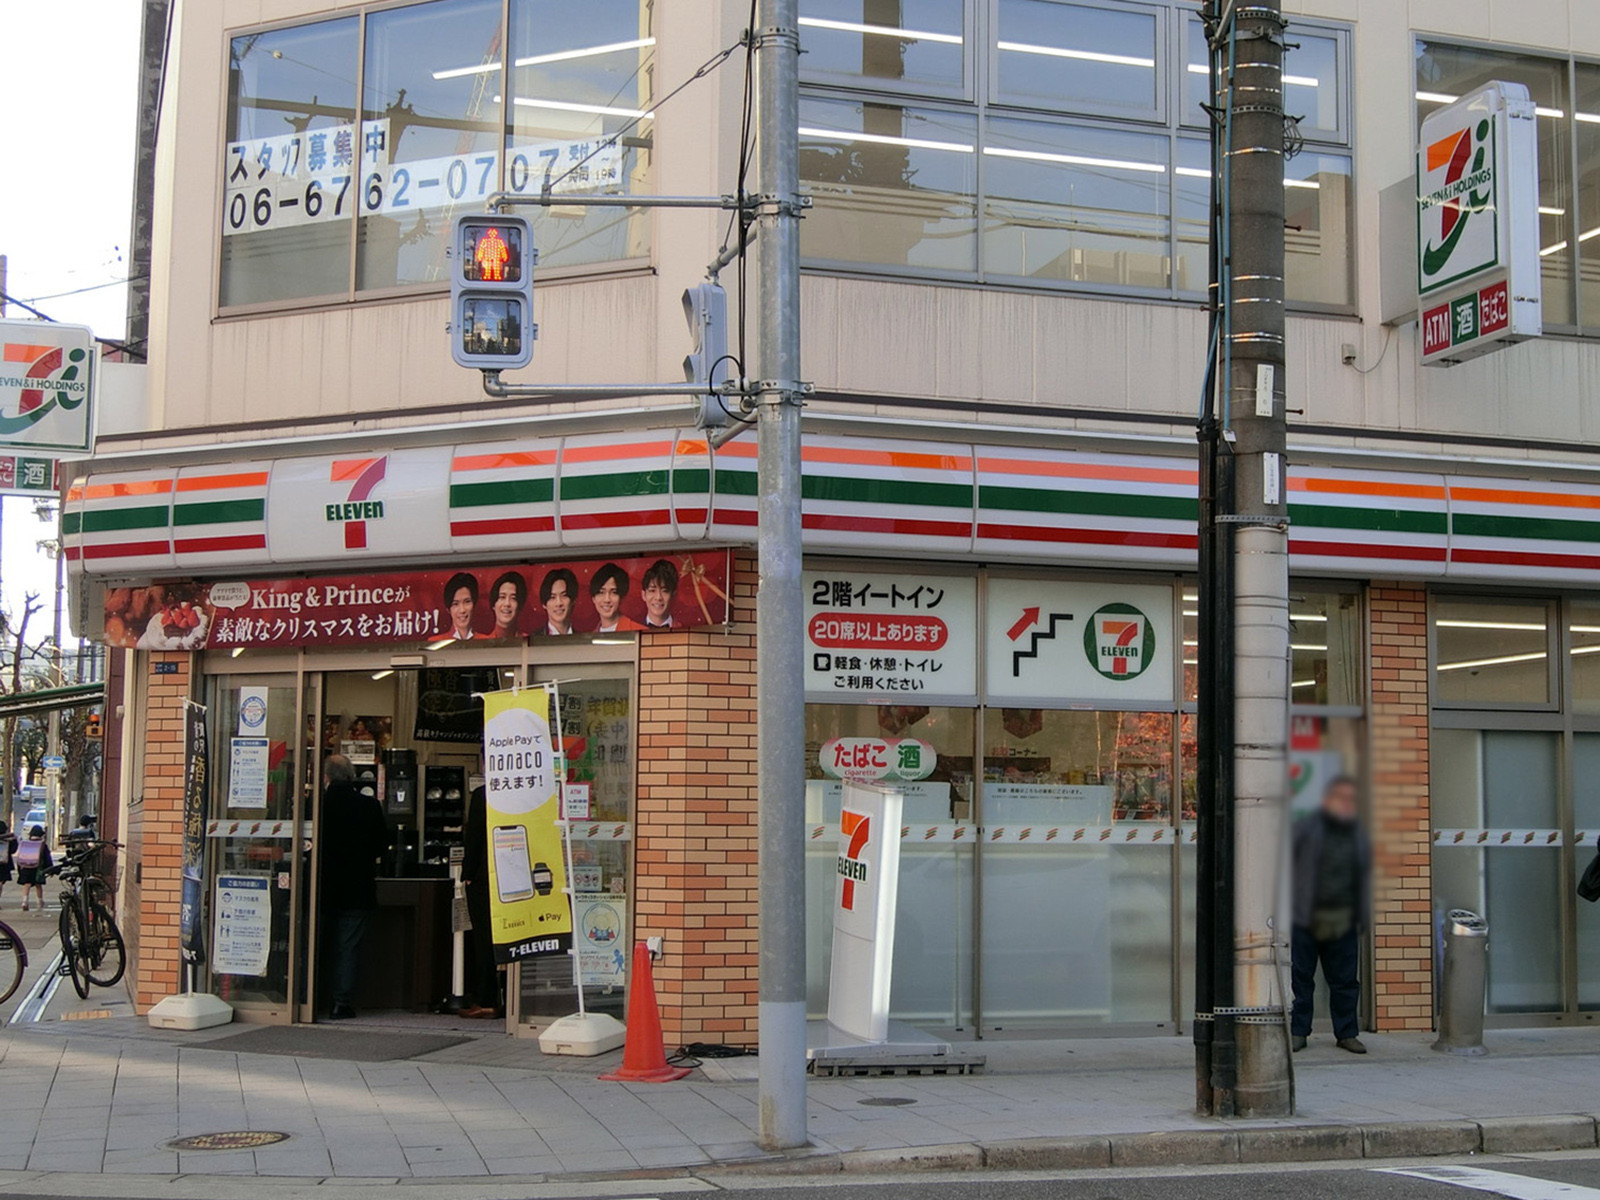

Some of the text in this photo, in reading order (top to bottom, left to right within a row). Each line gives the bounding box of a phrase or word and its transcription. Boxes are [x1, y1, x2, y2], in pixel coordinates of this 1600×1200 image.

[231, 124, 385, 183] スタッフ募集中
[1453, 168, 1491, 193] HOLDINGS
[1456, 302, 1473, 338] 酒
[1481, 291, 1507, 327] たばこ
[1425, 312, 1449, 348] ATM
[36, 379, 85, 392] HOLDINGS
[24, 463, 46, 485] 酒
[251, 589, 303, 613] King
[305, 586, 321, 607] &
[813, 581, 944, 608] 2階イートイン
[216, 609, 440, 642] 素敵なクリスマスをお届け!
[814, 621, 942, 643] 20席以上あります
[834, 656, 943, 672] 軽食・休憩・トイレ
[834, 676, 924, 690] ご利用ください
[489, 738, 513, 747] Apple
[489, 751, 542, 771] nanaco
[834, 743, 887, 768] たばこ
[898, 744, 921, 769] 酒
[489, 775, 543, 791] 使えます!
[844, 770, 877, 778] cigarette
[545, 913, 561, 922] Pay
